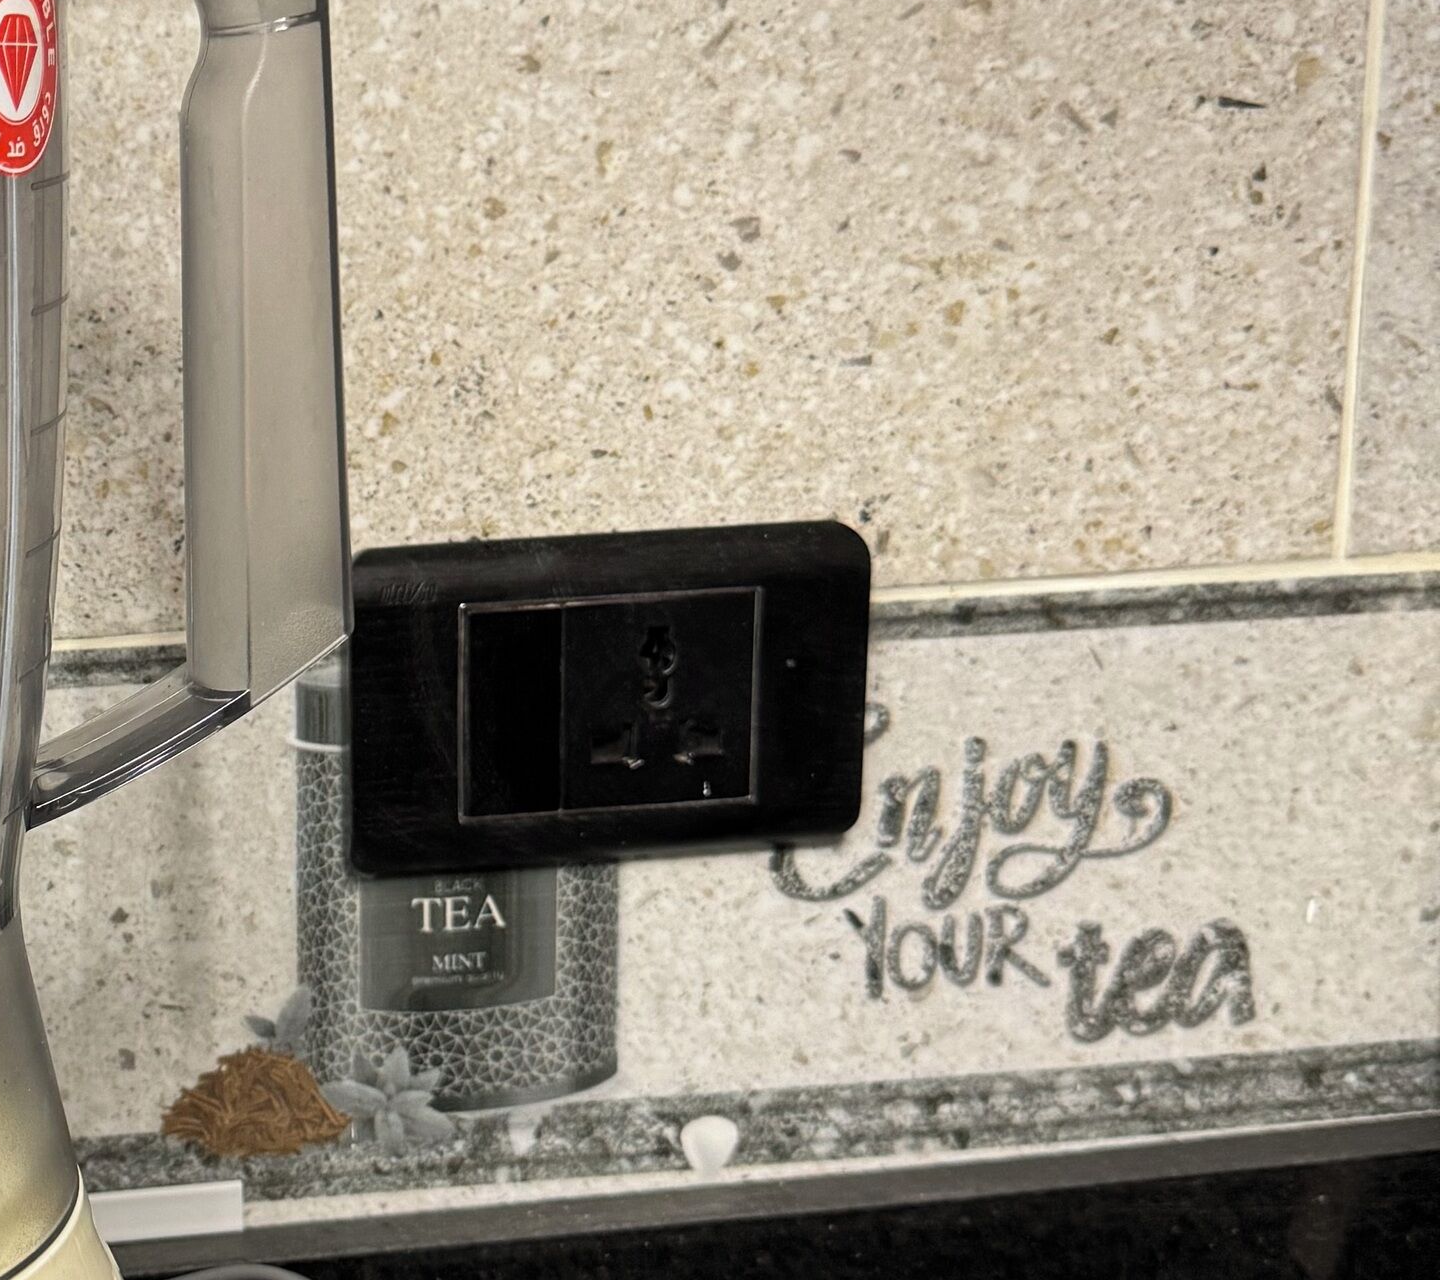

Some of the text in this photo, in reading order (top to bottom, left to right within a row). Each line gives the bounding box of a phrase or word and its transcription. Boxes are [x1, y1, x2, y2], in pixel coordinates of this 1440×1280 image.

[6, 135, 25, 157] ضد
[411, 894, 506, 933] TEA
[432, 951, 487, 971] MINT
[844, 896, 1051, 1000] YOUR
